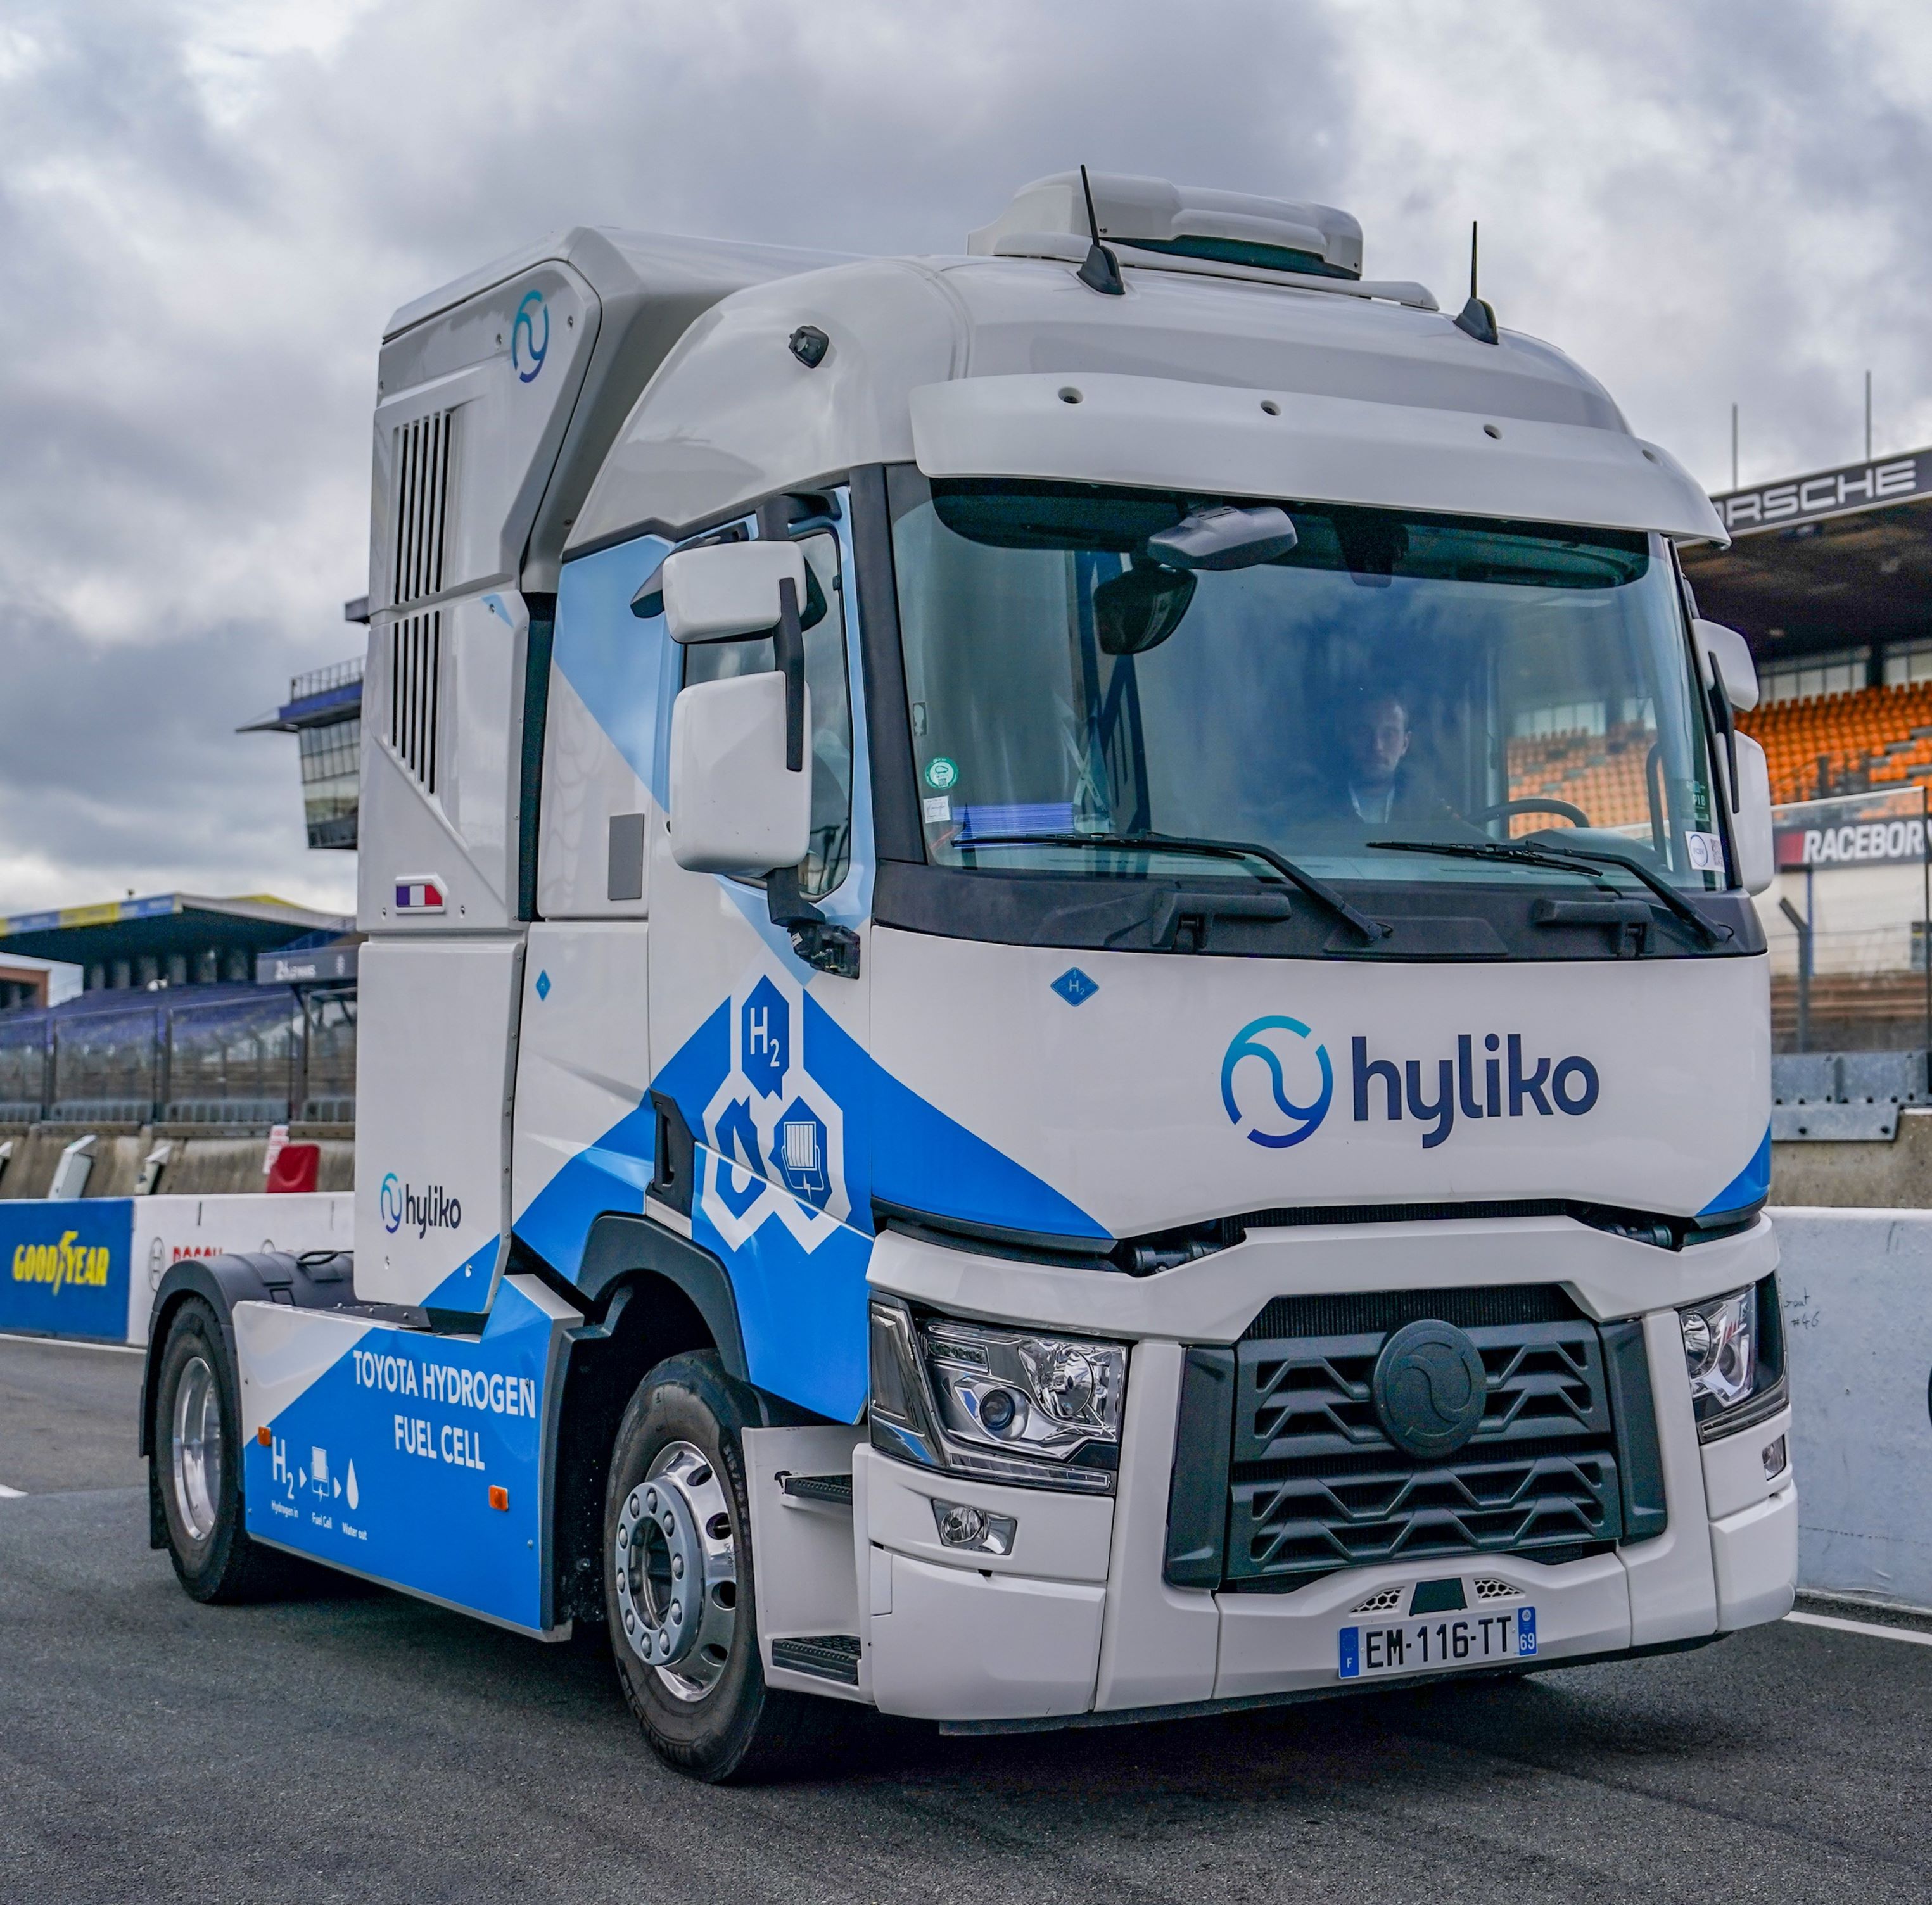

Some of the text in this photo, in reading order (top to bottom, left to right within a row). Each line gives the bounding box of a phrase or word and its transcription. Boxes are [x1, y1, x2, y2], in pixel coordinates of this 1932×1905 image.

[1712, 459, 1917, 527] RSCHE
[750, 1006, 780, 1068] H2
[1351, 1032, 1600, 1149] hyliko
[405, 1182, 462, 1240] hyliko
[13, 1229, 110, 1296] GOODYEAR
[352, 1350, 536, 1419] TOYOTA HYDROGEN
[394, 1414, 486, 1471] FUEL CELL
[312, 1512, 333, 1529] Fuel Cell
[342, 1521, 368, 1541] Water out
[1346, 1657, 1353, 1669] F
[1366, 1615, 1513, 1669] EM-116-TT
[1520, 1633, 1535, 1651] 69
